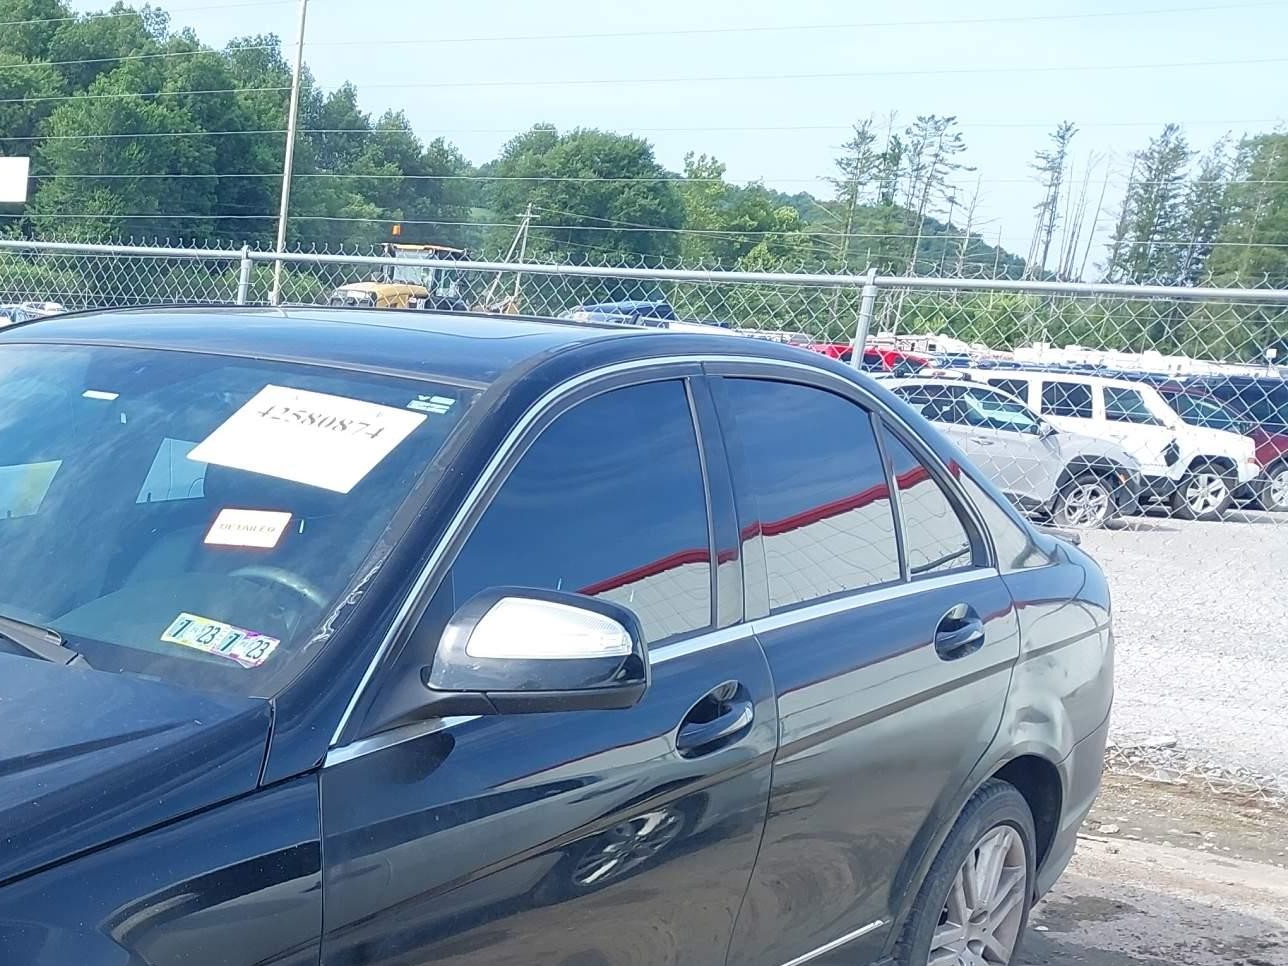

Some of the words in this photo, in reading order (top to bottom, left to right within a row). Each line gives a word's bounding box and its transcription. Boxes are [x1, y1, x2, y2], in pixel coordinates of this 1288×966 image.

[257, 405, 385, 439] 42580874
[196, 624, 222, 645] 23
[245, 639, 270, 660] 23
